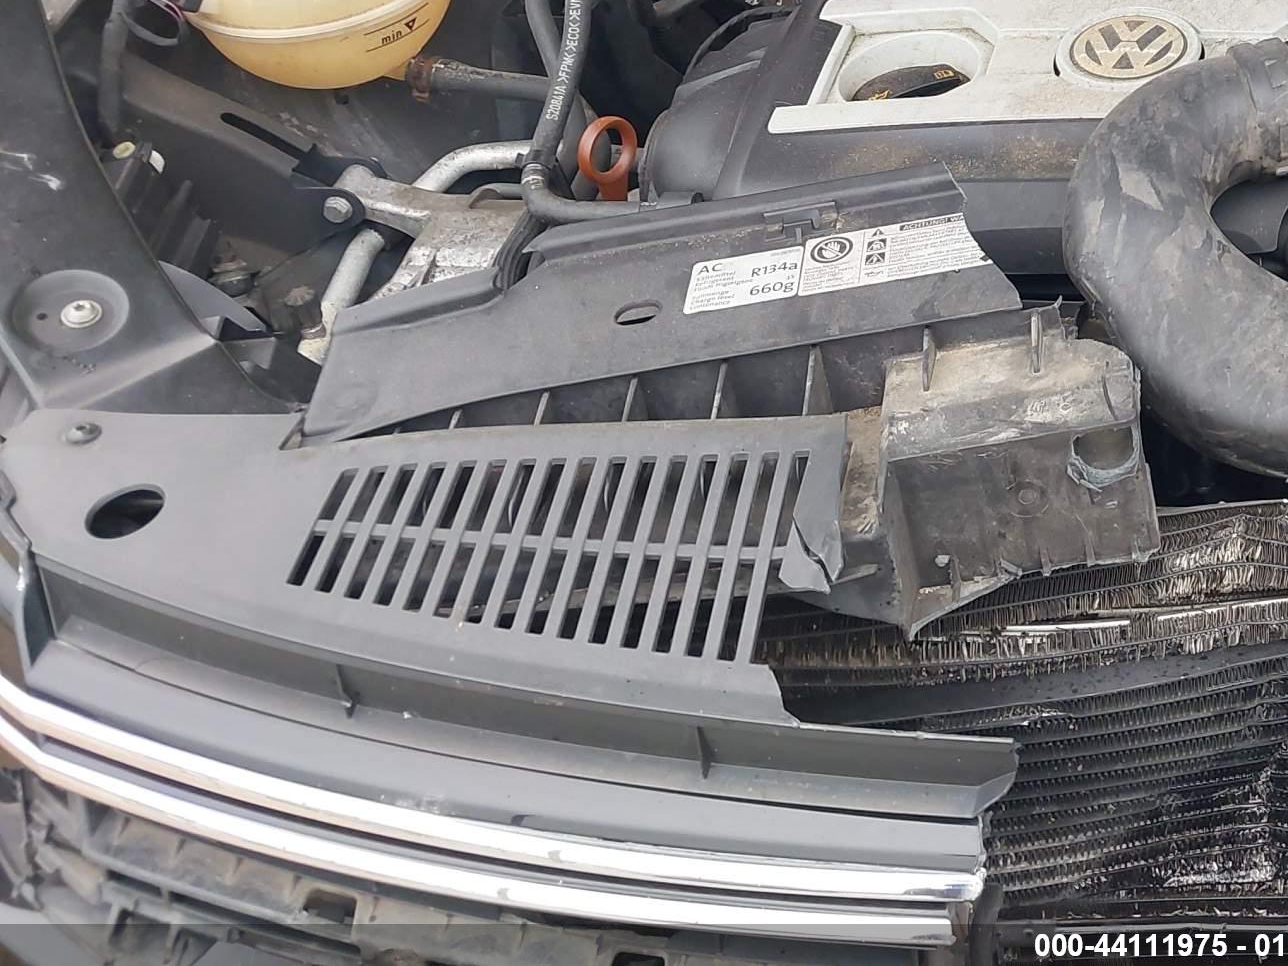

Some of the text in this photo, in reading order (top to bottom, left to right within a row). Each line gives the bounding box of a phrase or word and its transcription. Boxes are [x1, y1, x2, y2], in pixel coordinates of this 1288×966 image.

[381, 30, 402, 44] min
[902, 217, 949, 231] ACHTUNG!
[697, 262, 724, 275] AC
[751, 261, 798, 277] R134a
[749, 281, 795, 296] 660g
